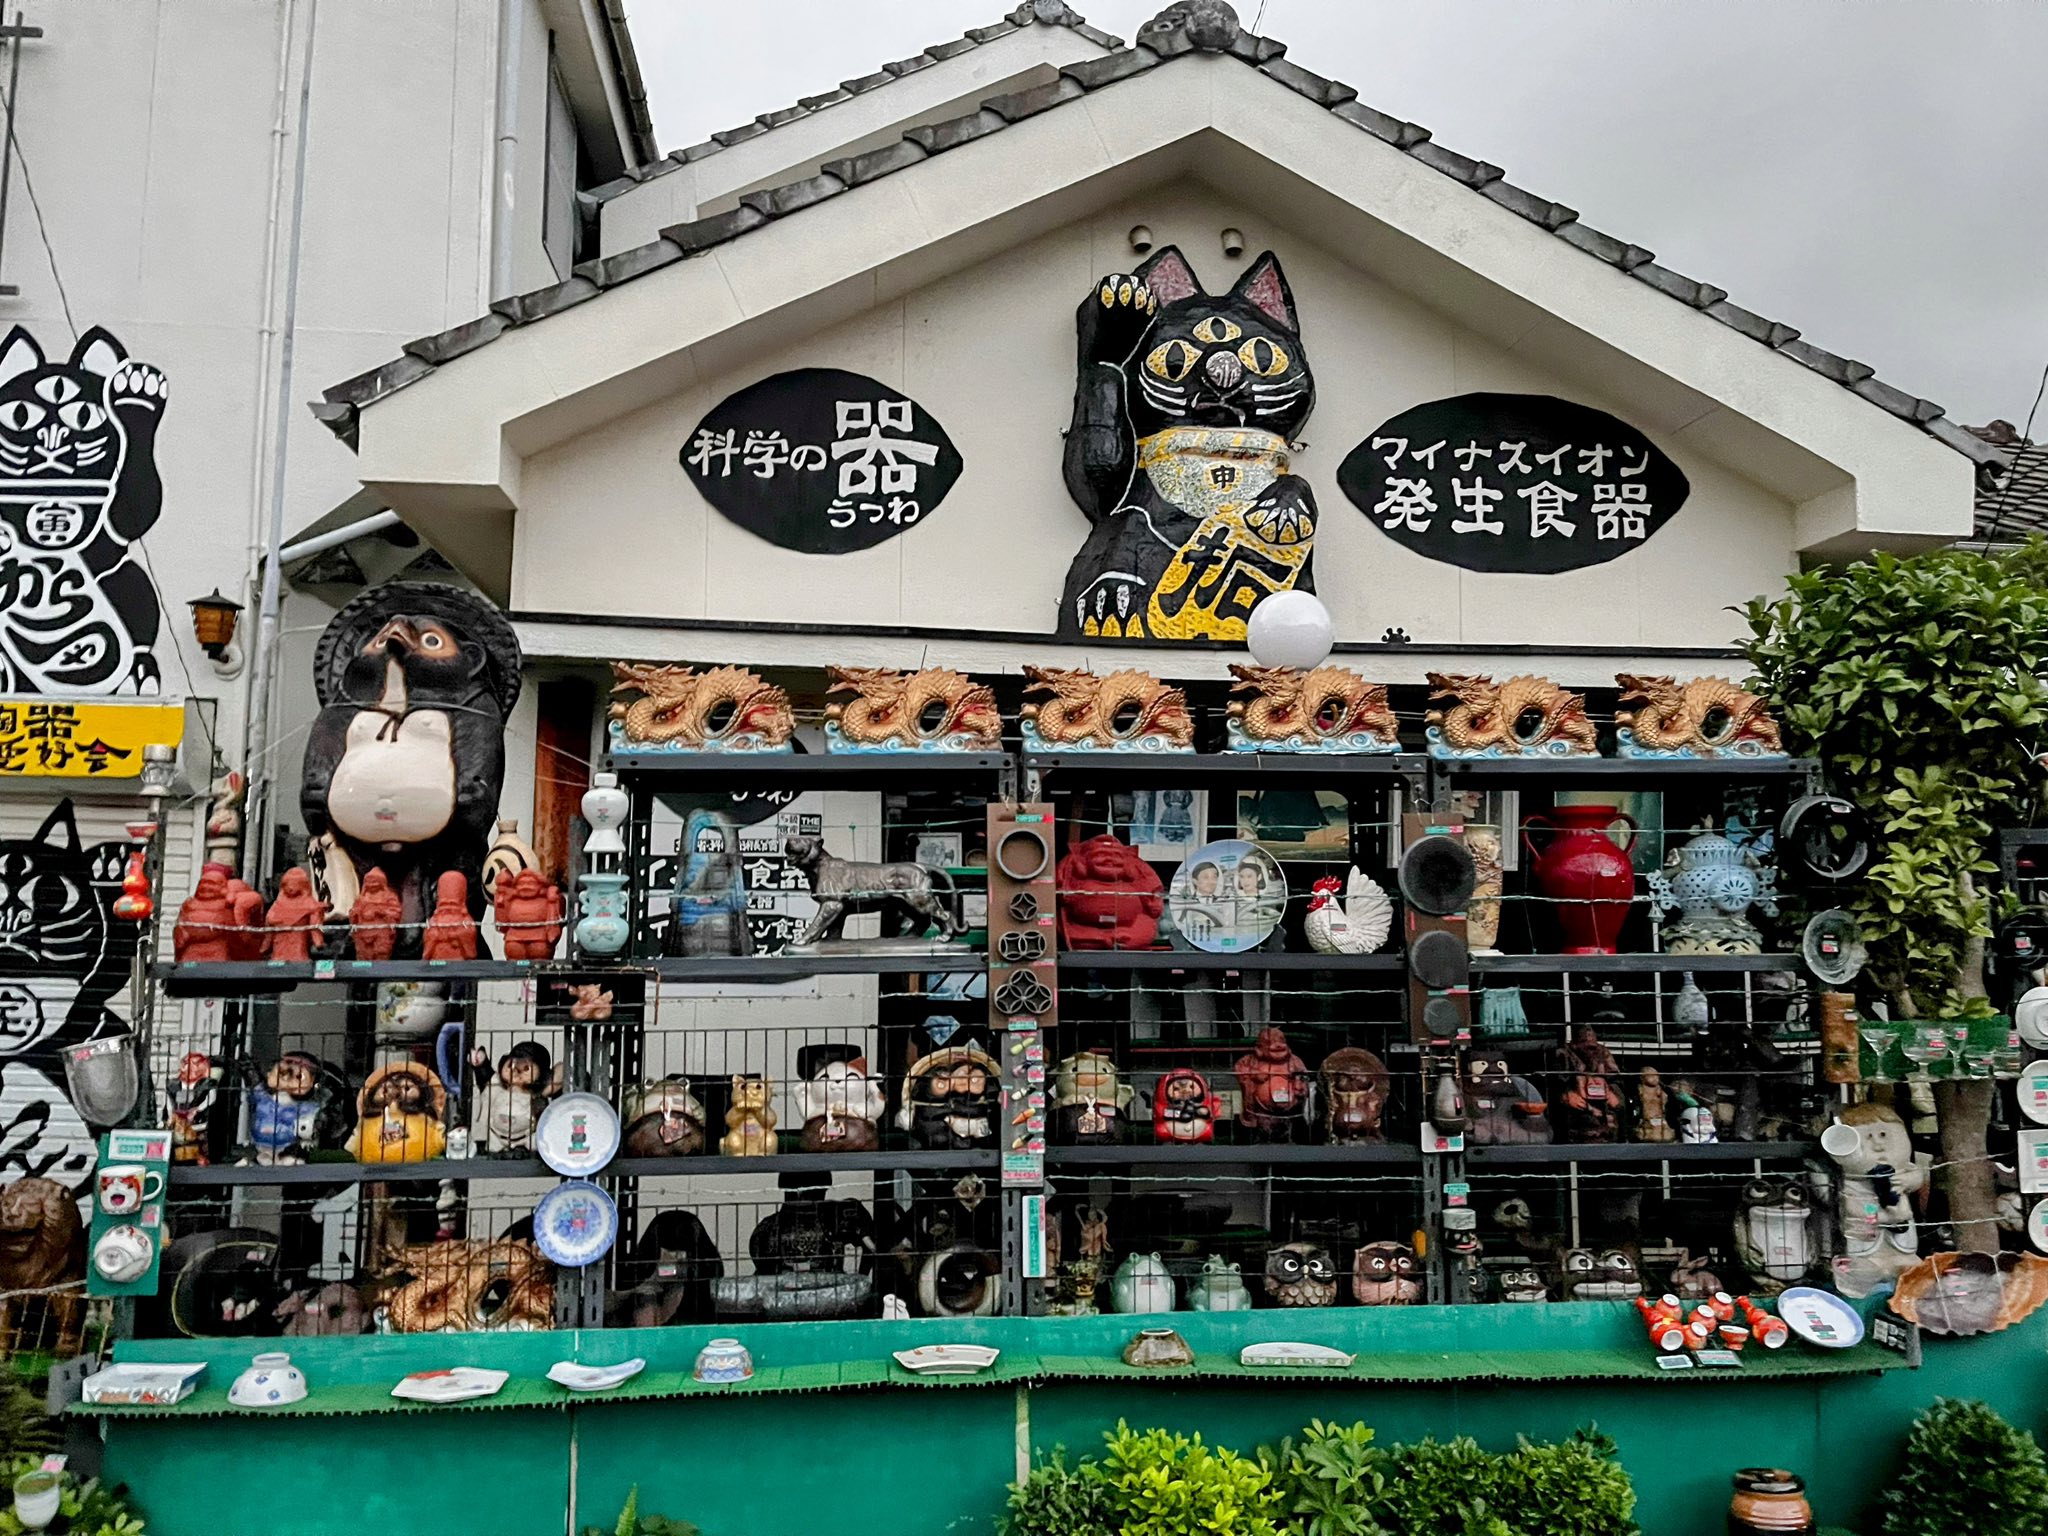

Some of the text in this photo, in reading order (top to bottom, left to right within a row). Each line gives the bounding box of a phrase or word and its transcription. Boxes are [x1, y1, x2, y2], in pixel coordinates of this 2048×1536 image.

[1372, 437, 1649, 478] マイナスイオン
[36, 503, 76, 542] 寅
[827, 496, 920, 528] うつわ
[1373, 476, 1652, 540] 発生食器
